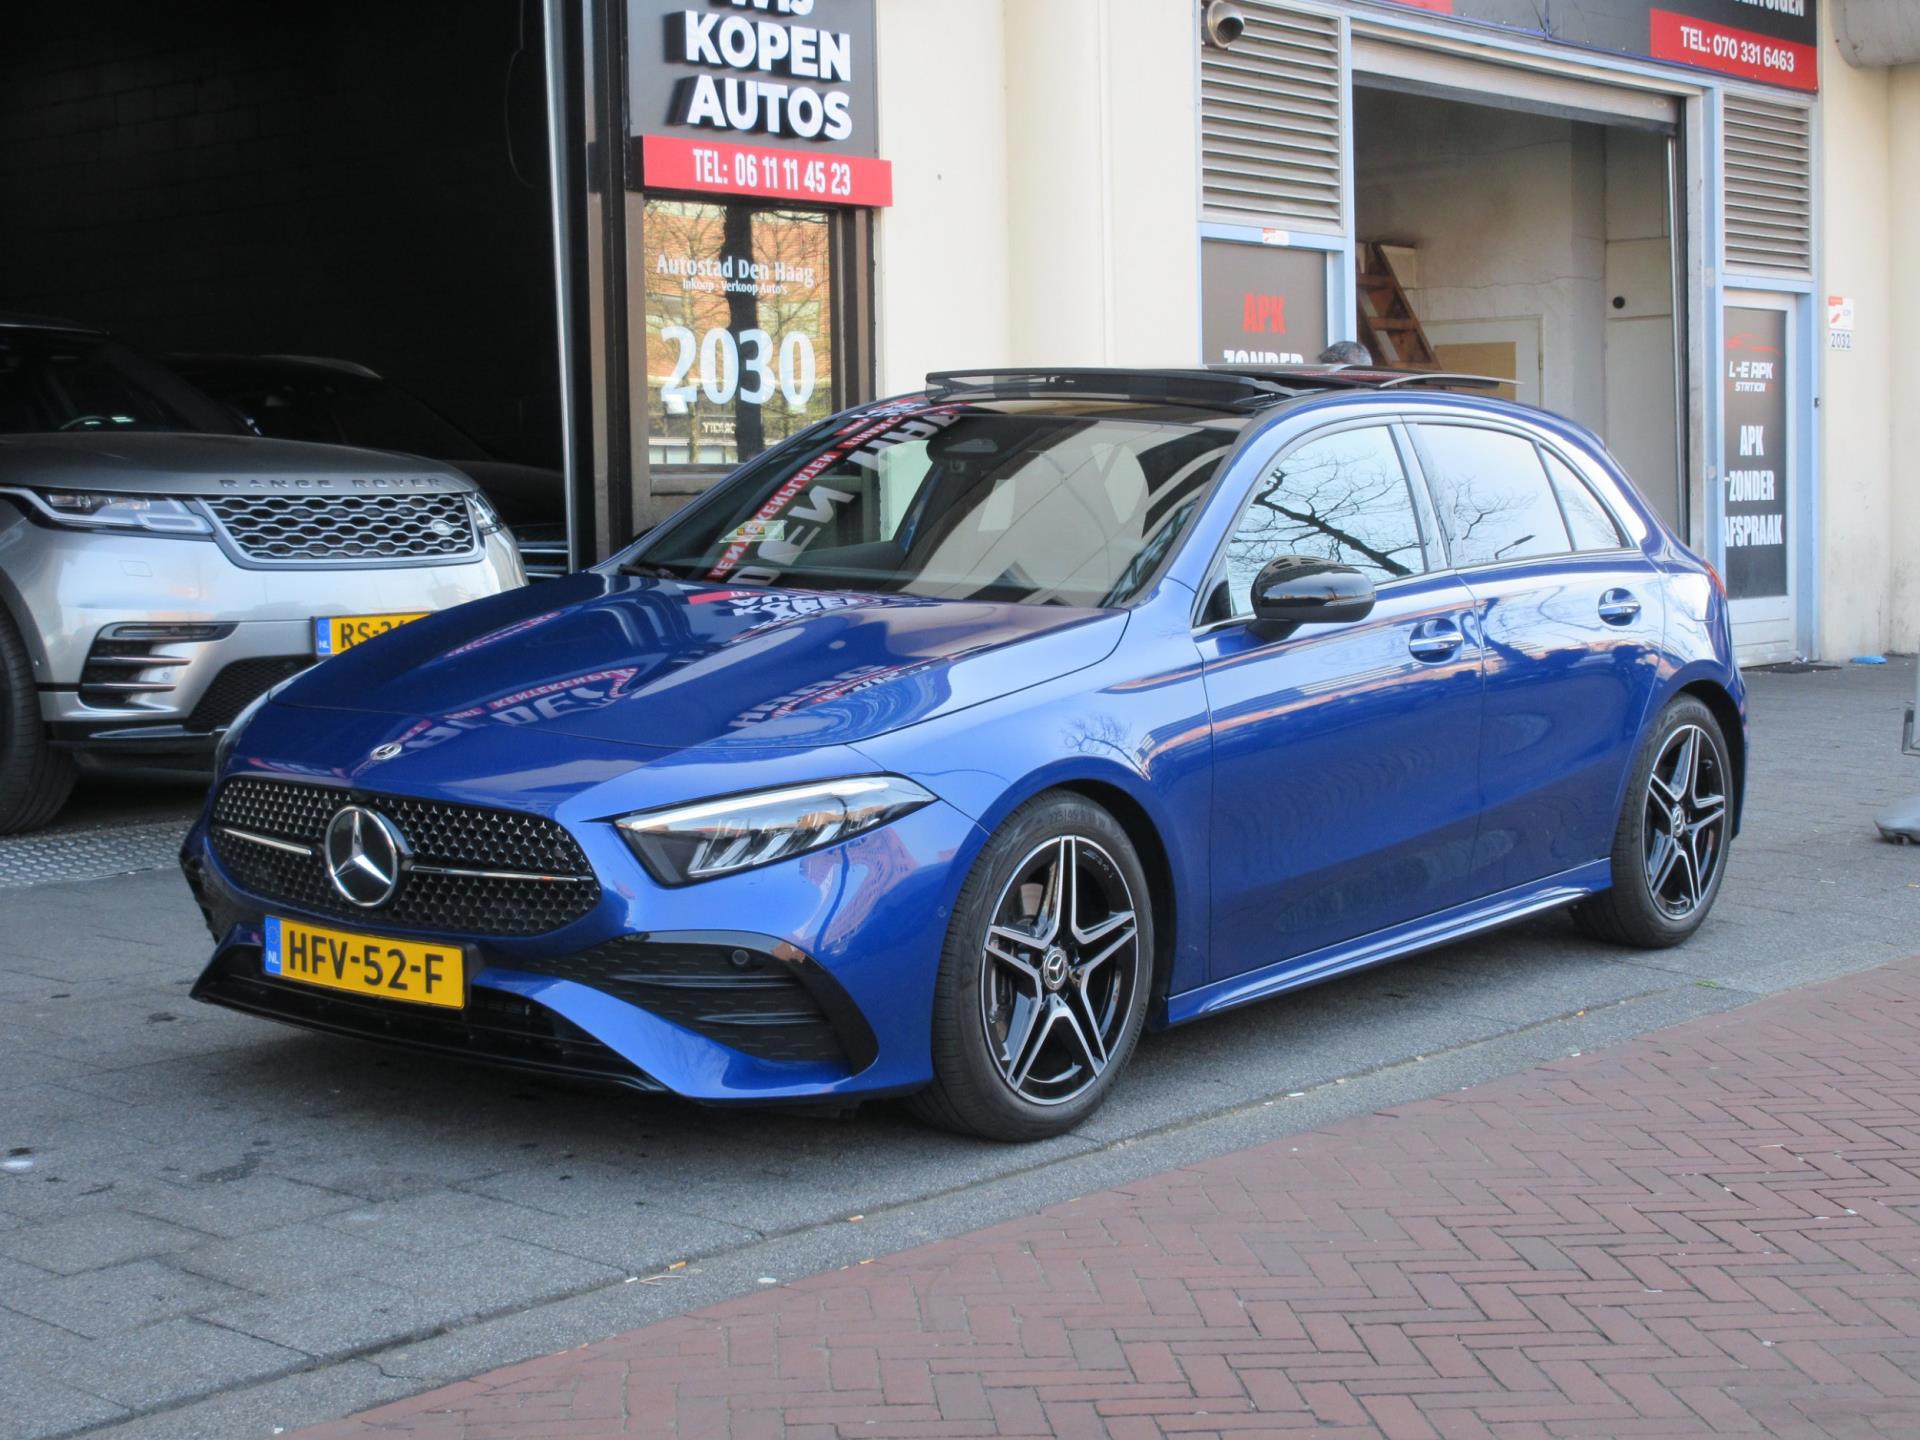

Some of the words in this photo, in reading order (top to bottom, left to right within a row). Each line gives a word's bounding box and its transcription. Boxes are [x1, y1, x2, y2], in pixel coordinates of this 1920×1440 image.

[685, 10, 851, 82] KOPEN
[1680, 26, 1711, 54] TEL:
[1713, 34, 1738, 60] 070
[1741, 41, 1761, 65] 331
[1763, 46, 1795, 73] 6463
[687, 74, 853, 141] AUTOS
[692, 148, 728, 185] TEL:
[735, 152, 758, 188] 06
[762, 156, 778, 190] 11
[783, 158, 799, 192] 11
[804, 160, 826, 194] 45
[831, 162, 851, 197] 23
[656, 254, 733, 279] Autostad
[738, 259, 770, 281] Den
[774, 261, 815, 289] Haag
[683, 278, 714, 293] Inkoop
[721, 280, 758, 297] Verkoop
[1243, 293, 1286, 335] APK
[1831, 333, 1851, 349] 2032
[661, 326, 816, 405] 2030
[1750, 361, 1774, 379] APK
[1740, 425, 1764, 456] APK
[219, 479, 335, 489] RANGE
[352, 478, 442, 488] ROVER
[1729, 470, 1775, 502] ZONDER
[1725, 514, 1783, 547] AFSPRAAK
[267, 950, 280, 965] NL
[289, 930, 444, 994] HFV-52-F
